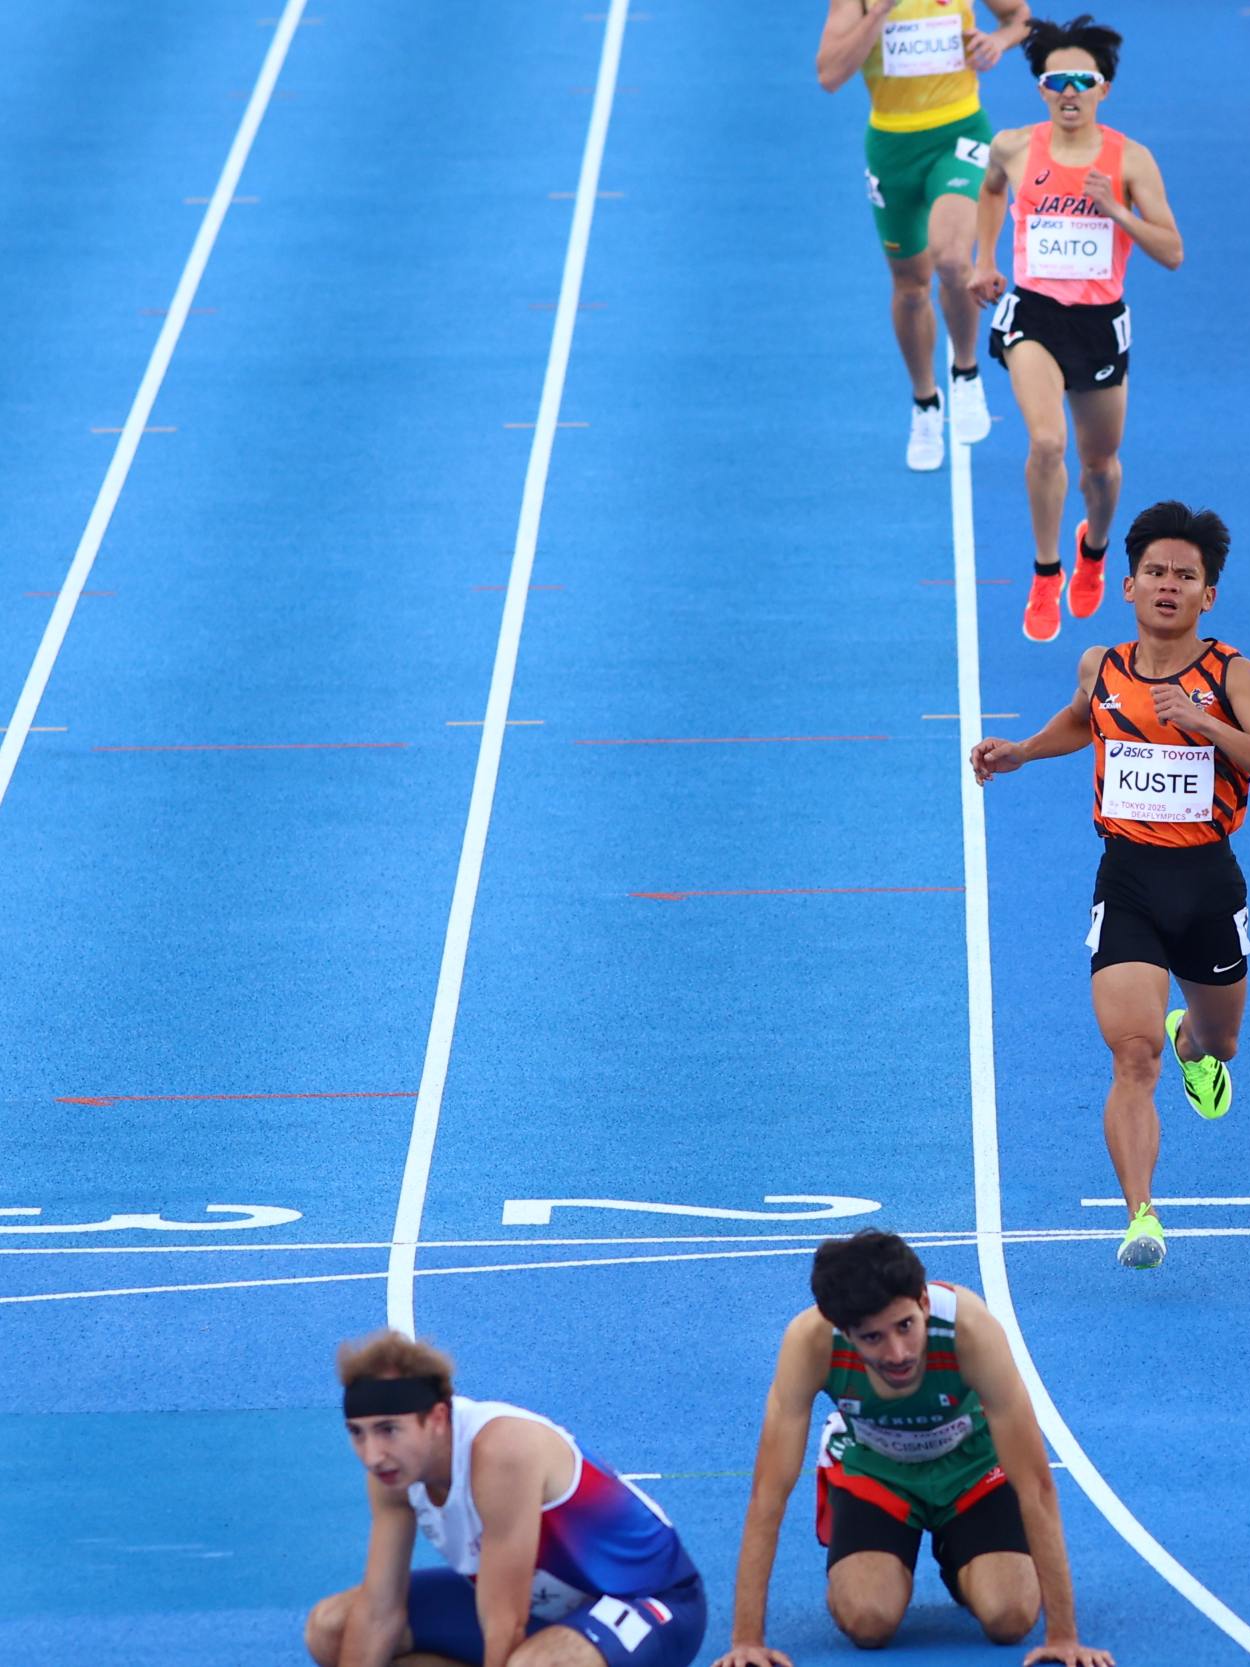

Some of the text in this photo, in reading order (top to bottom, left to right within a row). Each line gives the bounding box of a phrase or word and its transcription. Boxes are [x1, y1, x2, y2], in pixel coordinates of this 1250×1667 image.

[885, 35, 960, 55] VAICIULIS
[1071, 222, 1109, 230] TOYOTA
[1038, 238, 1098, 256] SAITO
[1123, 746, 1210, 761] asics TOYOTA
[1119, 769, 1199, 794] KUSTE
[1121, 801, 1146, 811] TOKYO
[1147, 804, 1167, 812] 2025
[1131, 811, 1187, 821] DEAFLYMPICS
[502, 1195, 882, 1225] 2
